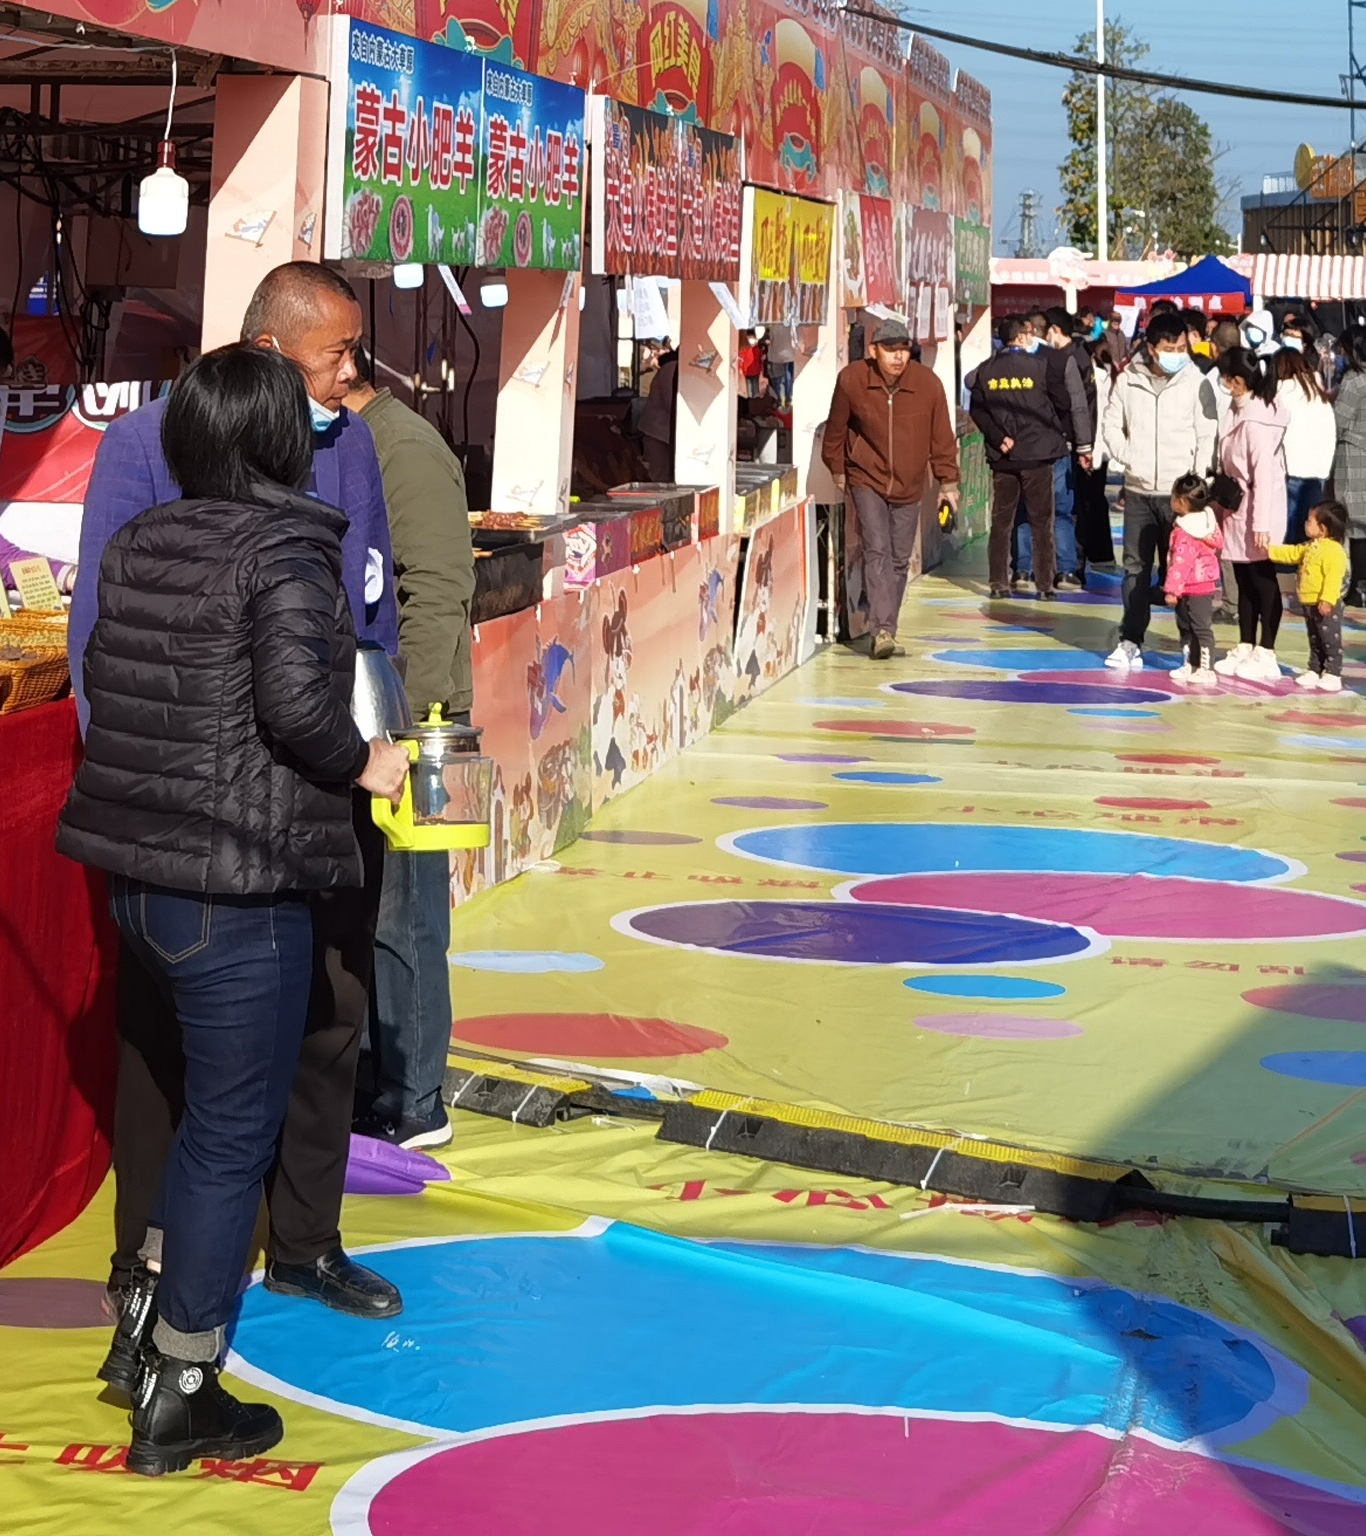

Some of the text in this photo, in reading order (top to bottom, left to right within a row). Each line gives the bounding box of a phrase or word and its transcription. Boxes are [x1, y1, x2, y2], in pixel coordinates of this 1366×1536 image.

[352, 81, 475, 195] 蒙古小肥羊
[486, 113, 579, 210] 蒙古小肥羊
